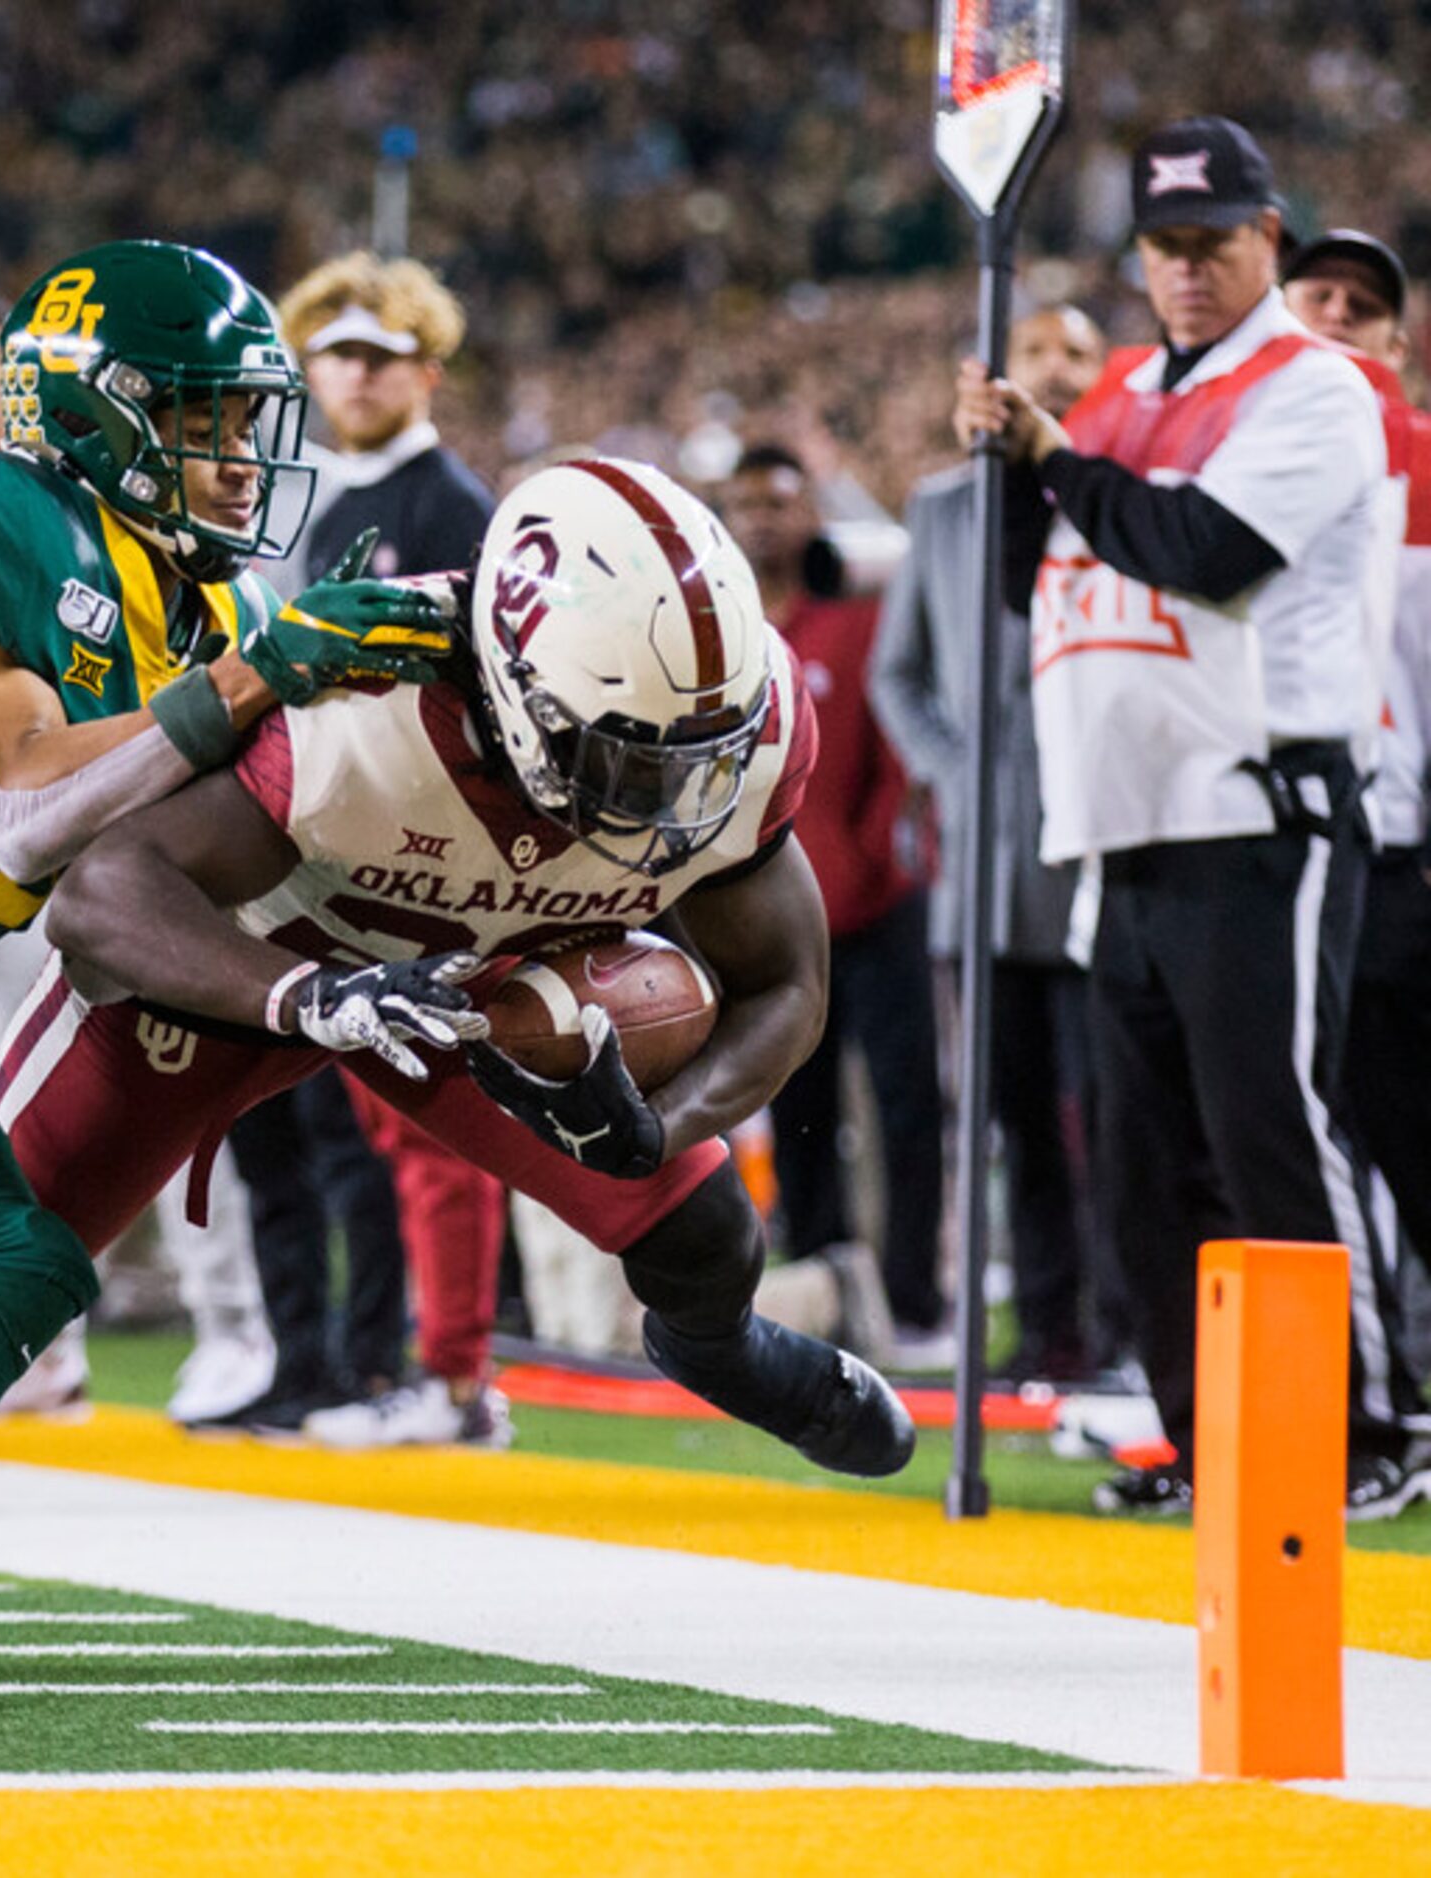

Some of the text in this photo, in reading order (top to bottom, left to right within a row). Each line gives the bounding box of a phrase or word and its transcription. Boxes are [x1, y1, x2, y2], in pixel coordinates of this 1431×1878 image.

[26, 267, 106, 373] BU
[57, 577, 120, 645] 150
[395, 827, 455, 861] XII
[511, 834, 541, 868] OU
[349, 866, 661, 919] OKLAHOMA
